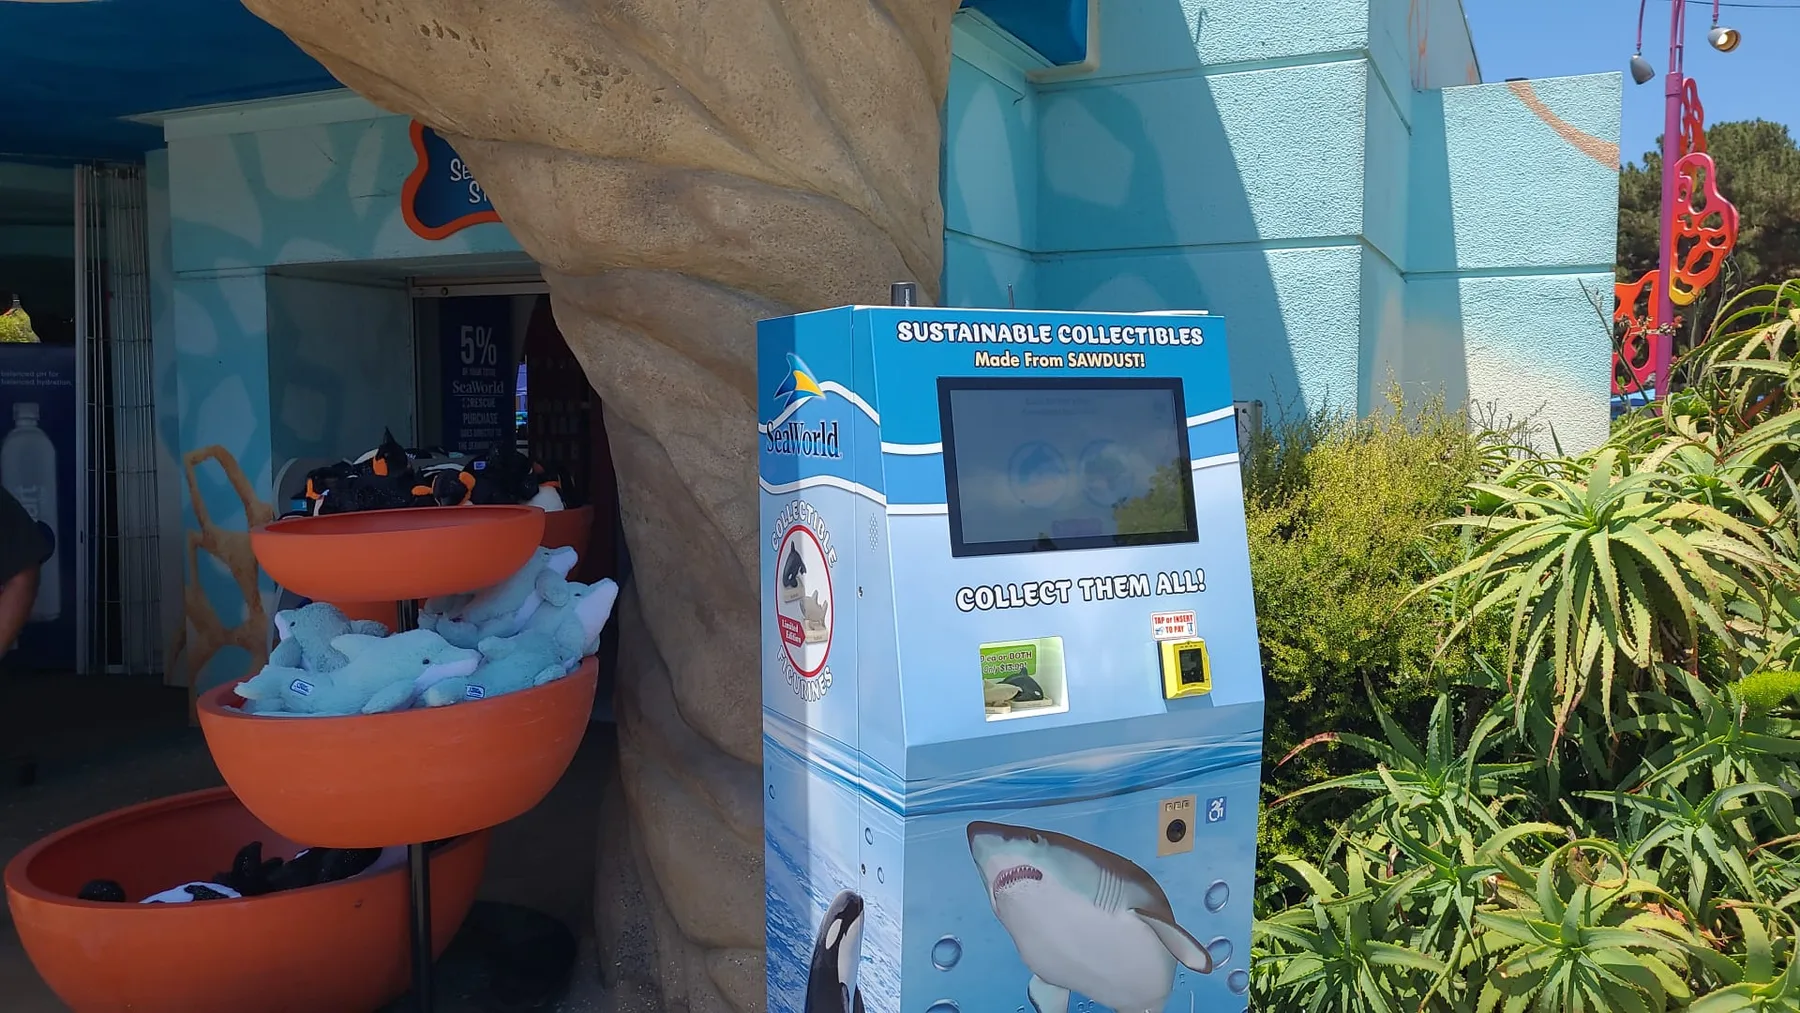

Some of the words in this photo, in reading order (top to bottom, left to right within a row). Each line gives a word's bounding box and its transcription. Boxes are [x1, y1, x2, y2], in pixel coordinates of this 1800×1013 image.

[897, 321, 1053, 345] SUSTAINABLE
[1058, 325, 1204, 346] COLLECTIBLES
[460, 325, 497, 366] 5%
[974, 351, 1020, 369] Made
[1024, 352, 1063, 369] From
[1068, 352, 1146, 369] SAWDUST!
[453, 380, 505, 394] SeaWorld
[463, 412, 499, 425] PURCHASE
[766, 420, 841, 459] SeaWorld
[771, 499, 838, 569] COLLECTIBLE
[956, 578, 1072, 612] COLLECT
[1077, 573, 1151, 602] THEM
[1156, 568, 1206, 596] ALL!
[781, 618, 799, 633] Limited
[1154, 616, 1165, 625] TAP
[1173, 614, 1193, 623] INSERT
[785, 630, 802, 644] Edition
[1165, 626, 1173, 634] TO
[1174, 625, 1184, 633] PAY
[1009, 650, 1032, 660] BOTH
[777, 644, 833, 703] FIGURINES
